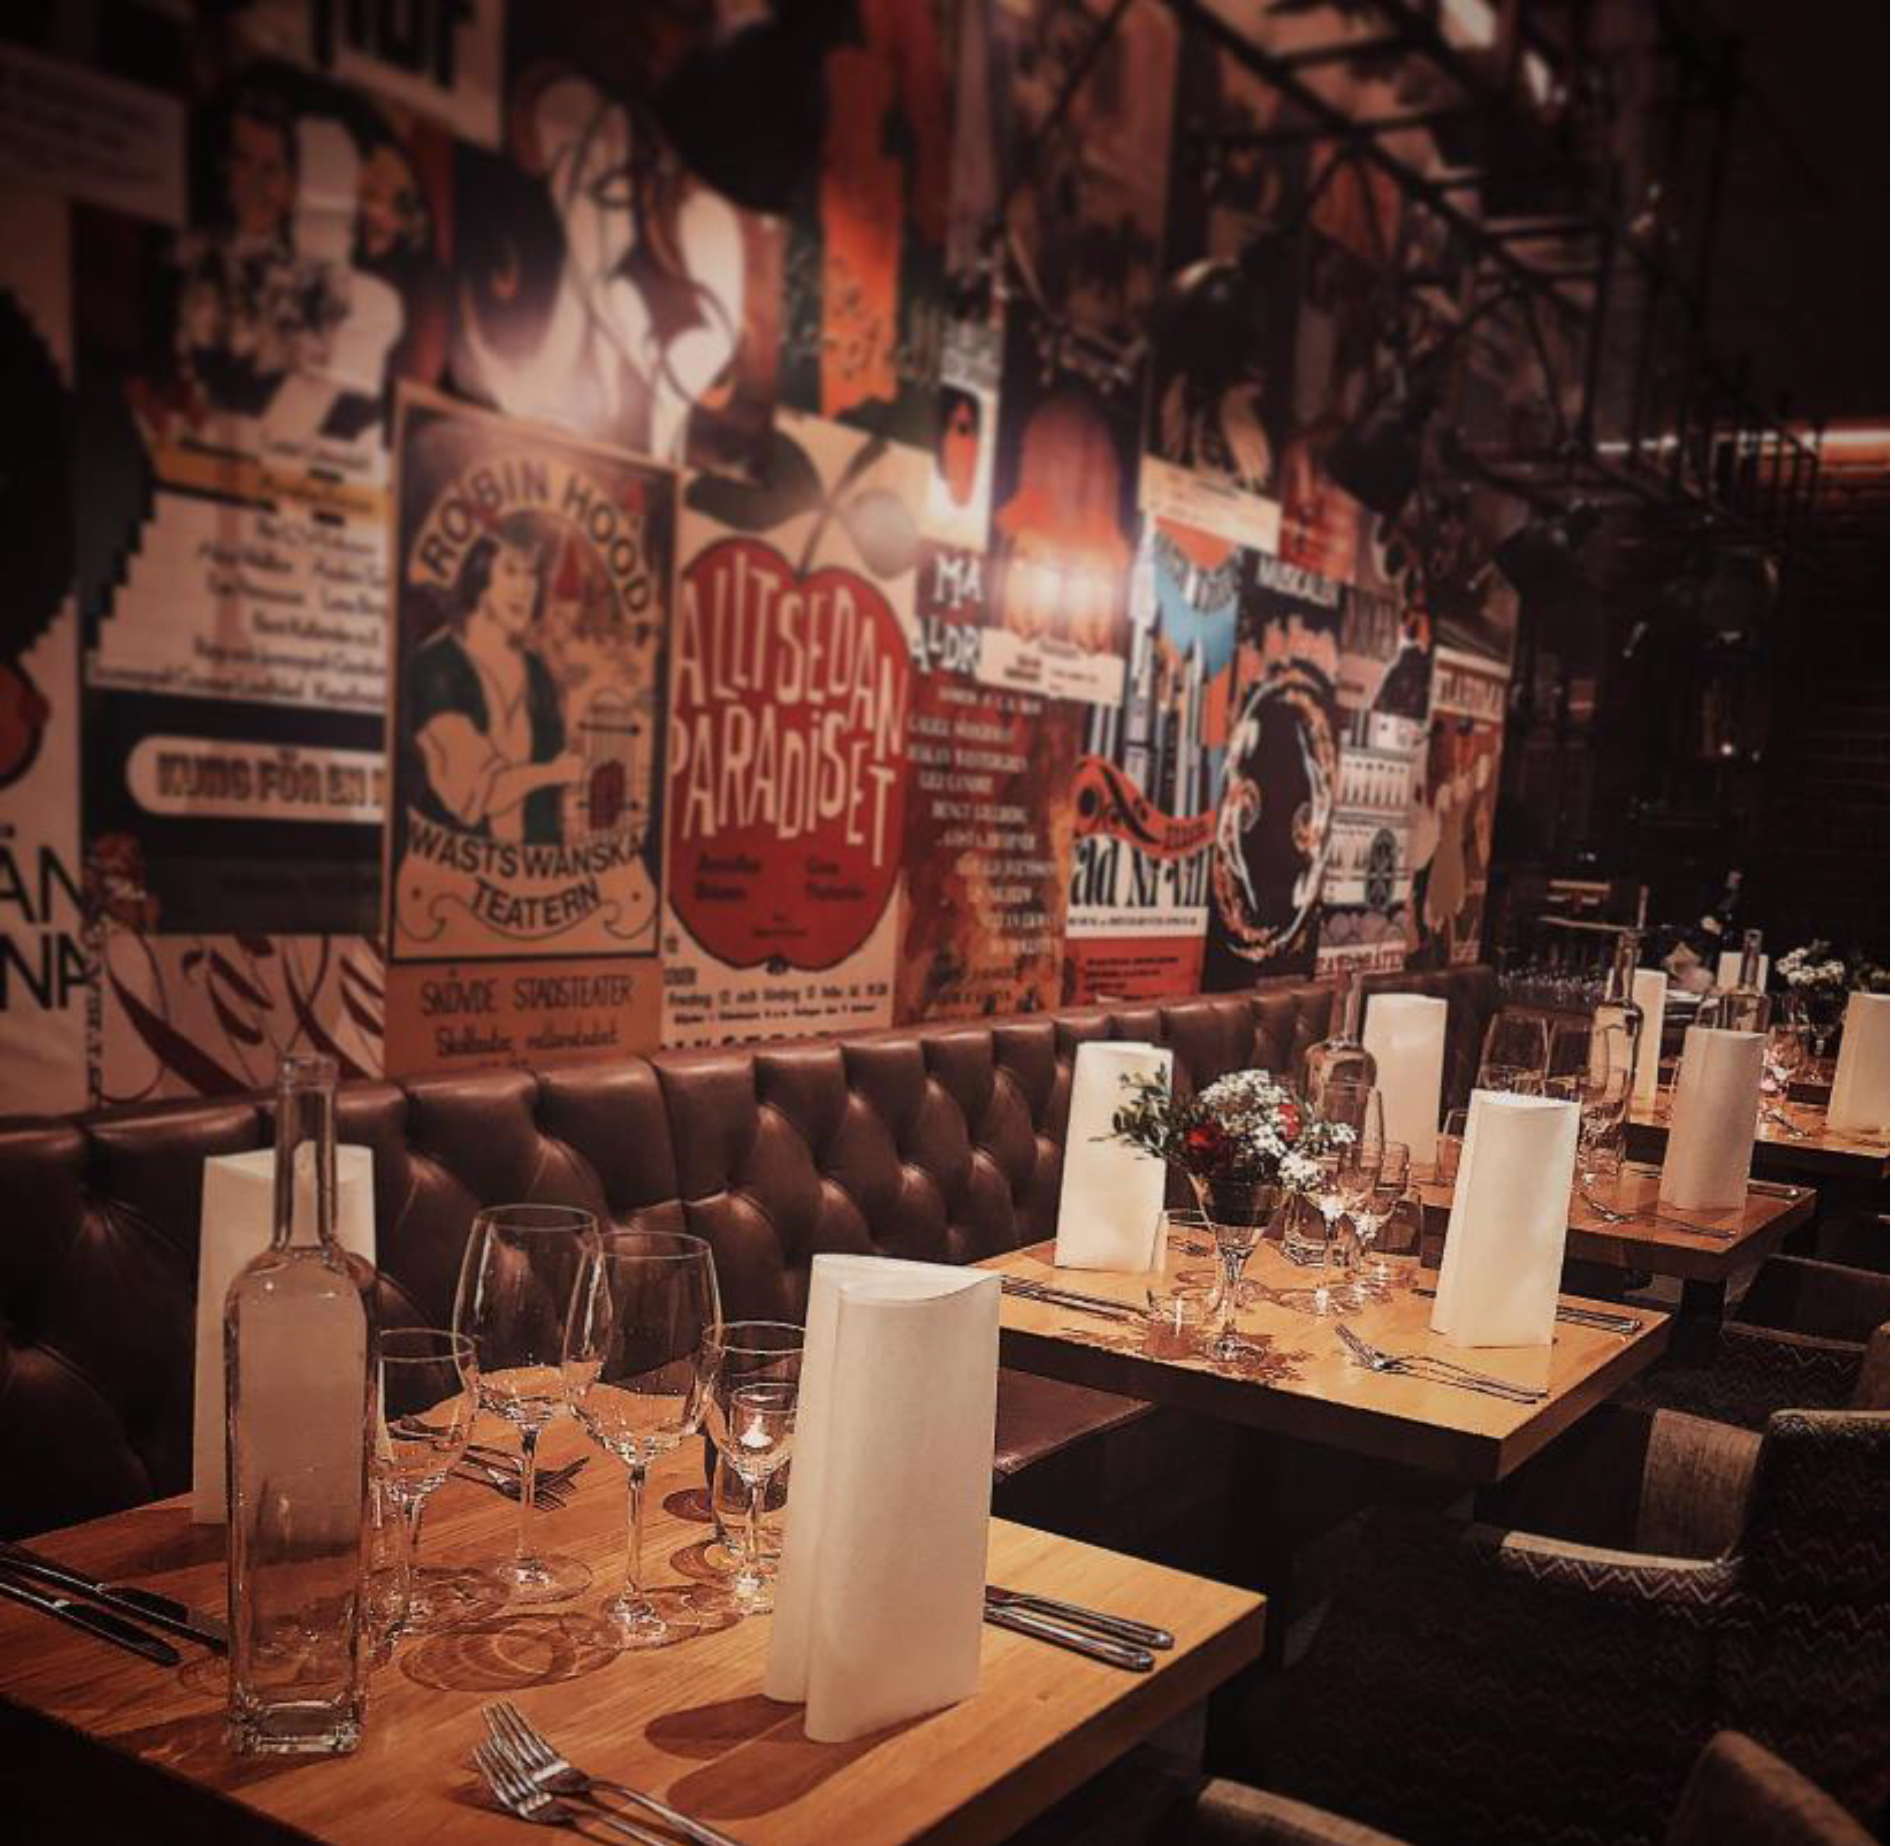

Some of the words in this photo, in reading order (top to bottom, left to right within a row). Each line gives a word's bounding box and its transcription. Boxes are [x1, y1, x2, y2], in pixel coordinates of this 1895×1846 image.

[418, 459, 550, 579] ROBIN
[561, 474, 648, 613] HOOD
[473, 875, 600, 930] TEATERN
[420, 966, 499, 1018] SKÖVDE
[513, 974, 634, 1013] STADSTEATER
